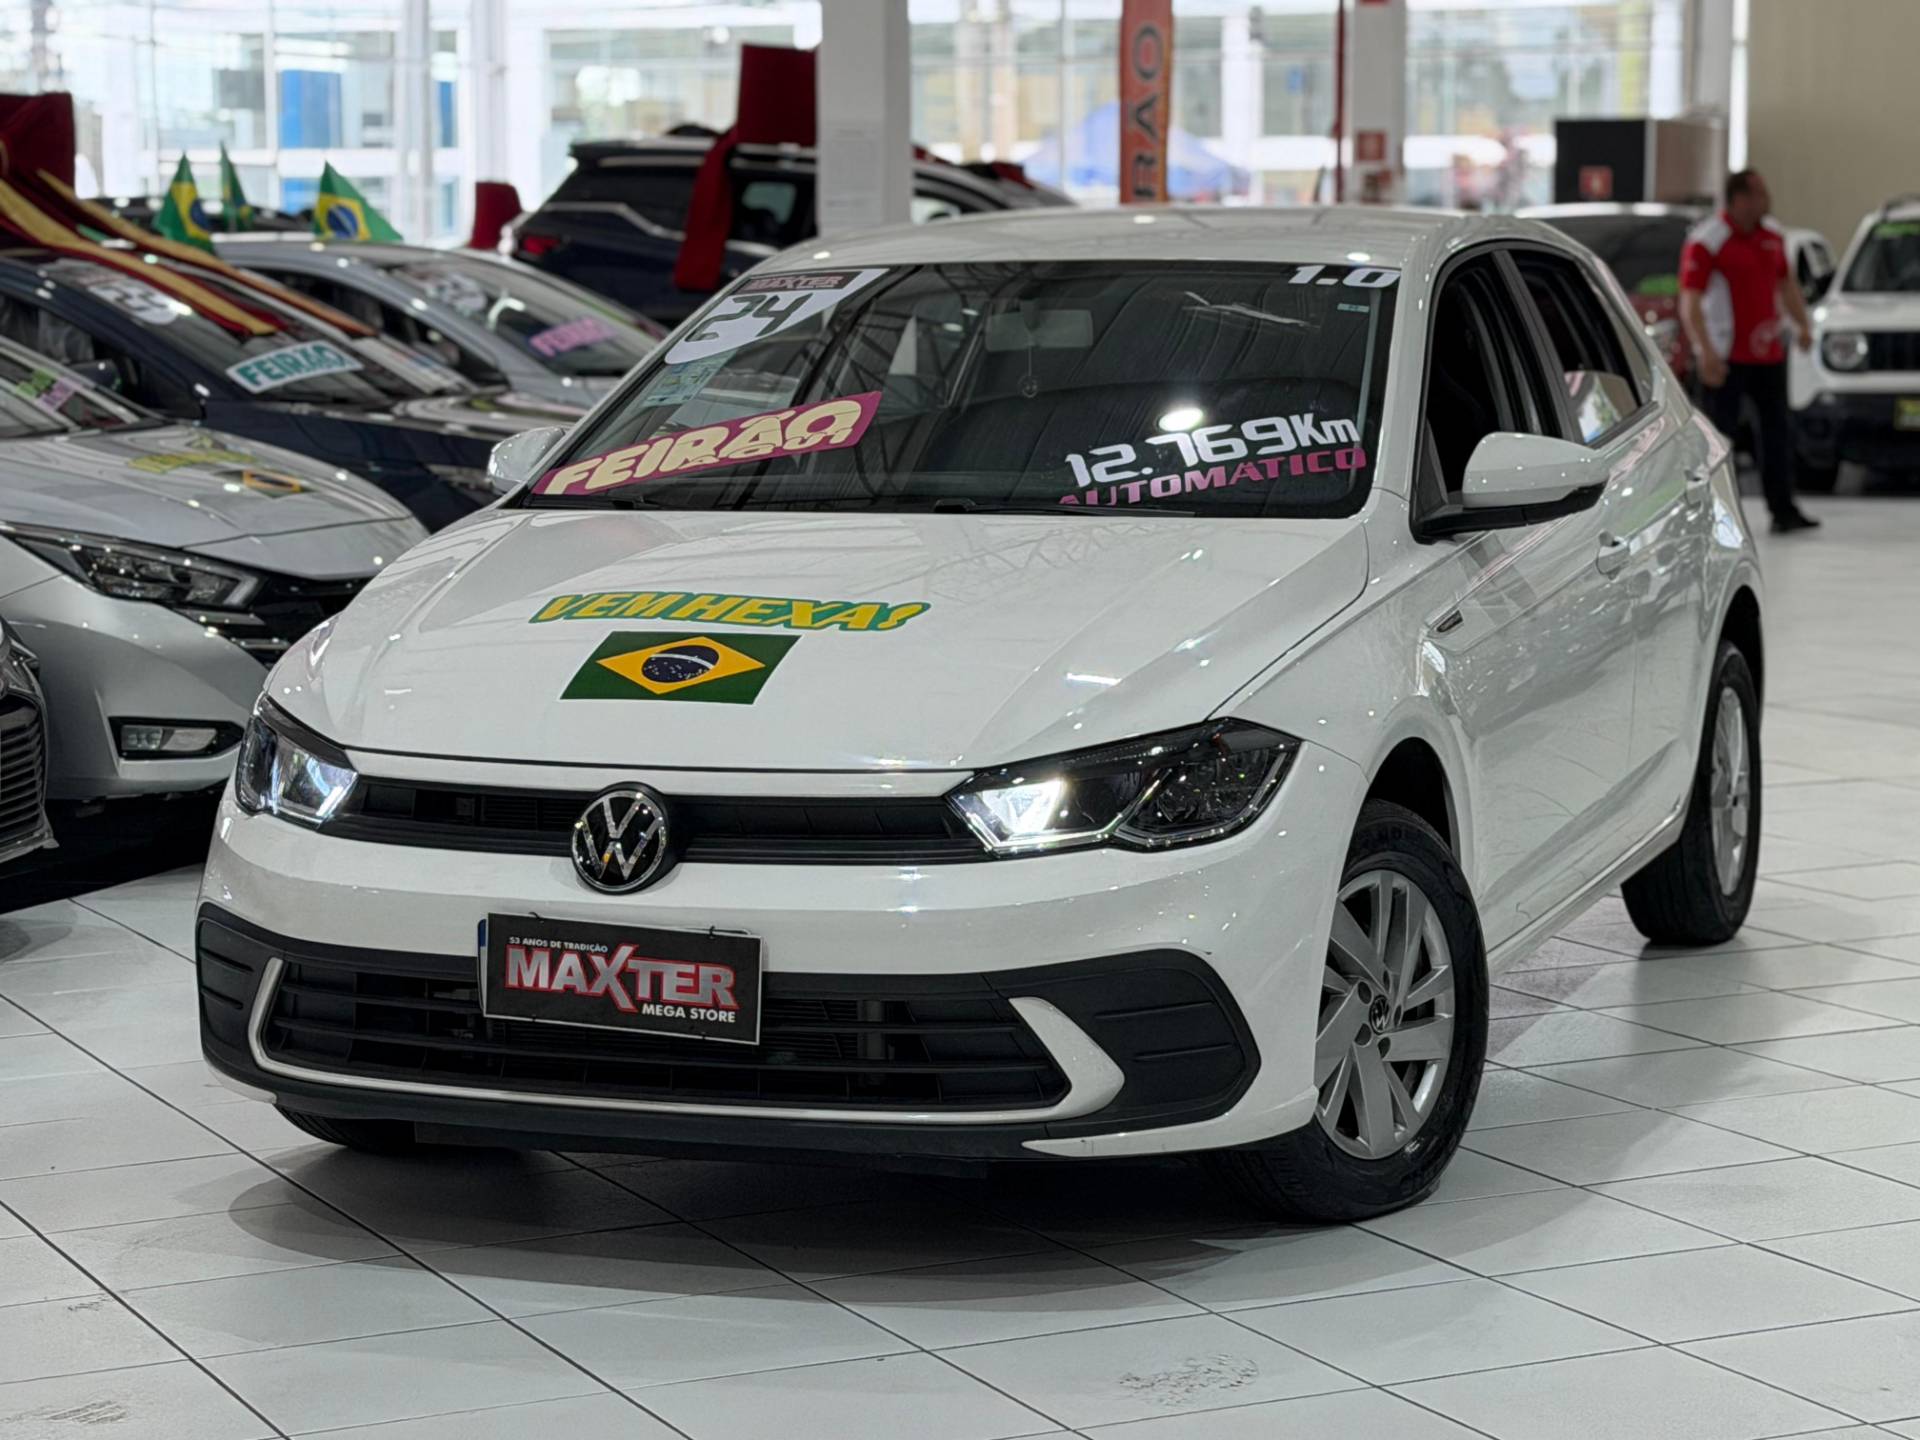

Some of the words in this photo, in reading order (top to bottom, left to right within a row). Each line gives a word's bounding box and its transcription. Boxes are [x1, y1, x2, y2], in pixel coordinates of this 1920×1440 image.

[1288, 264, 1402, 288] 1.0
[685, 292, 814, 343] 24
[543, 399, 863, 495] FEIRÃO
[508, 936, 521, 946] 53
[522, 937, 549, 948] ANOS
[550, 940, 562, 949] DE
[563, 941, 609, 954] TRADIÇÃO
[505, 944, 739, 1013] MAXTER
[641, 1003, 686, 1019] MEGA
[689, 1007, 736, 1023] STORE
